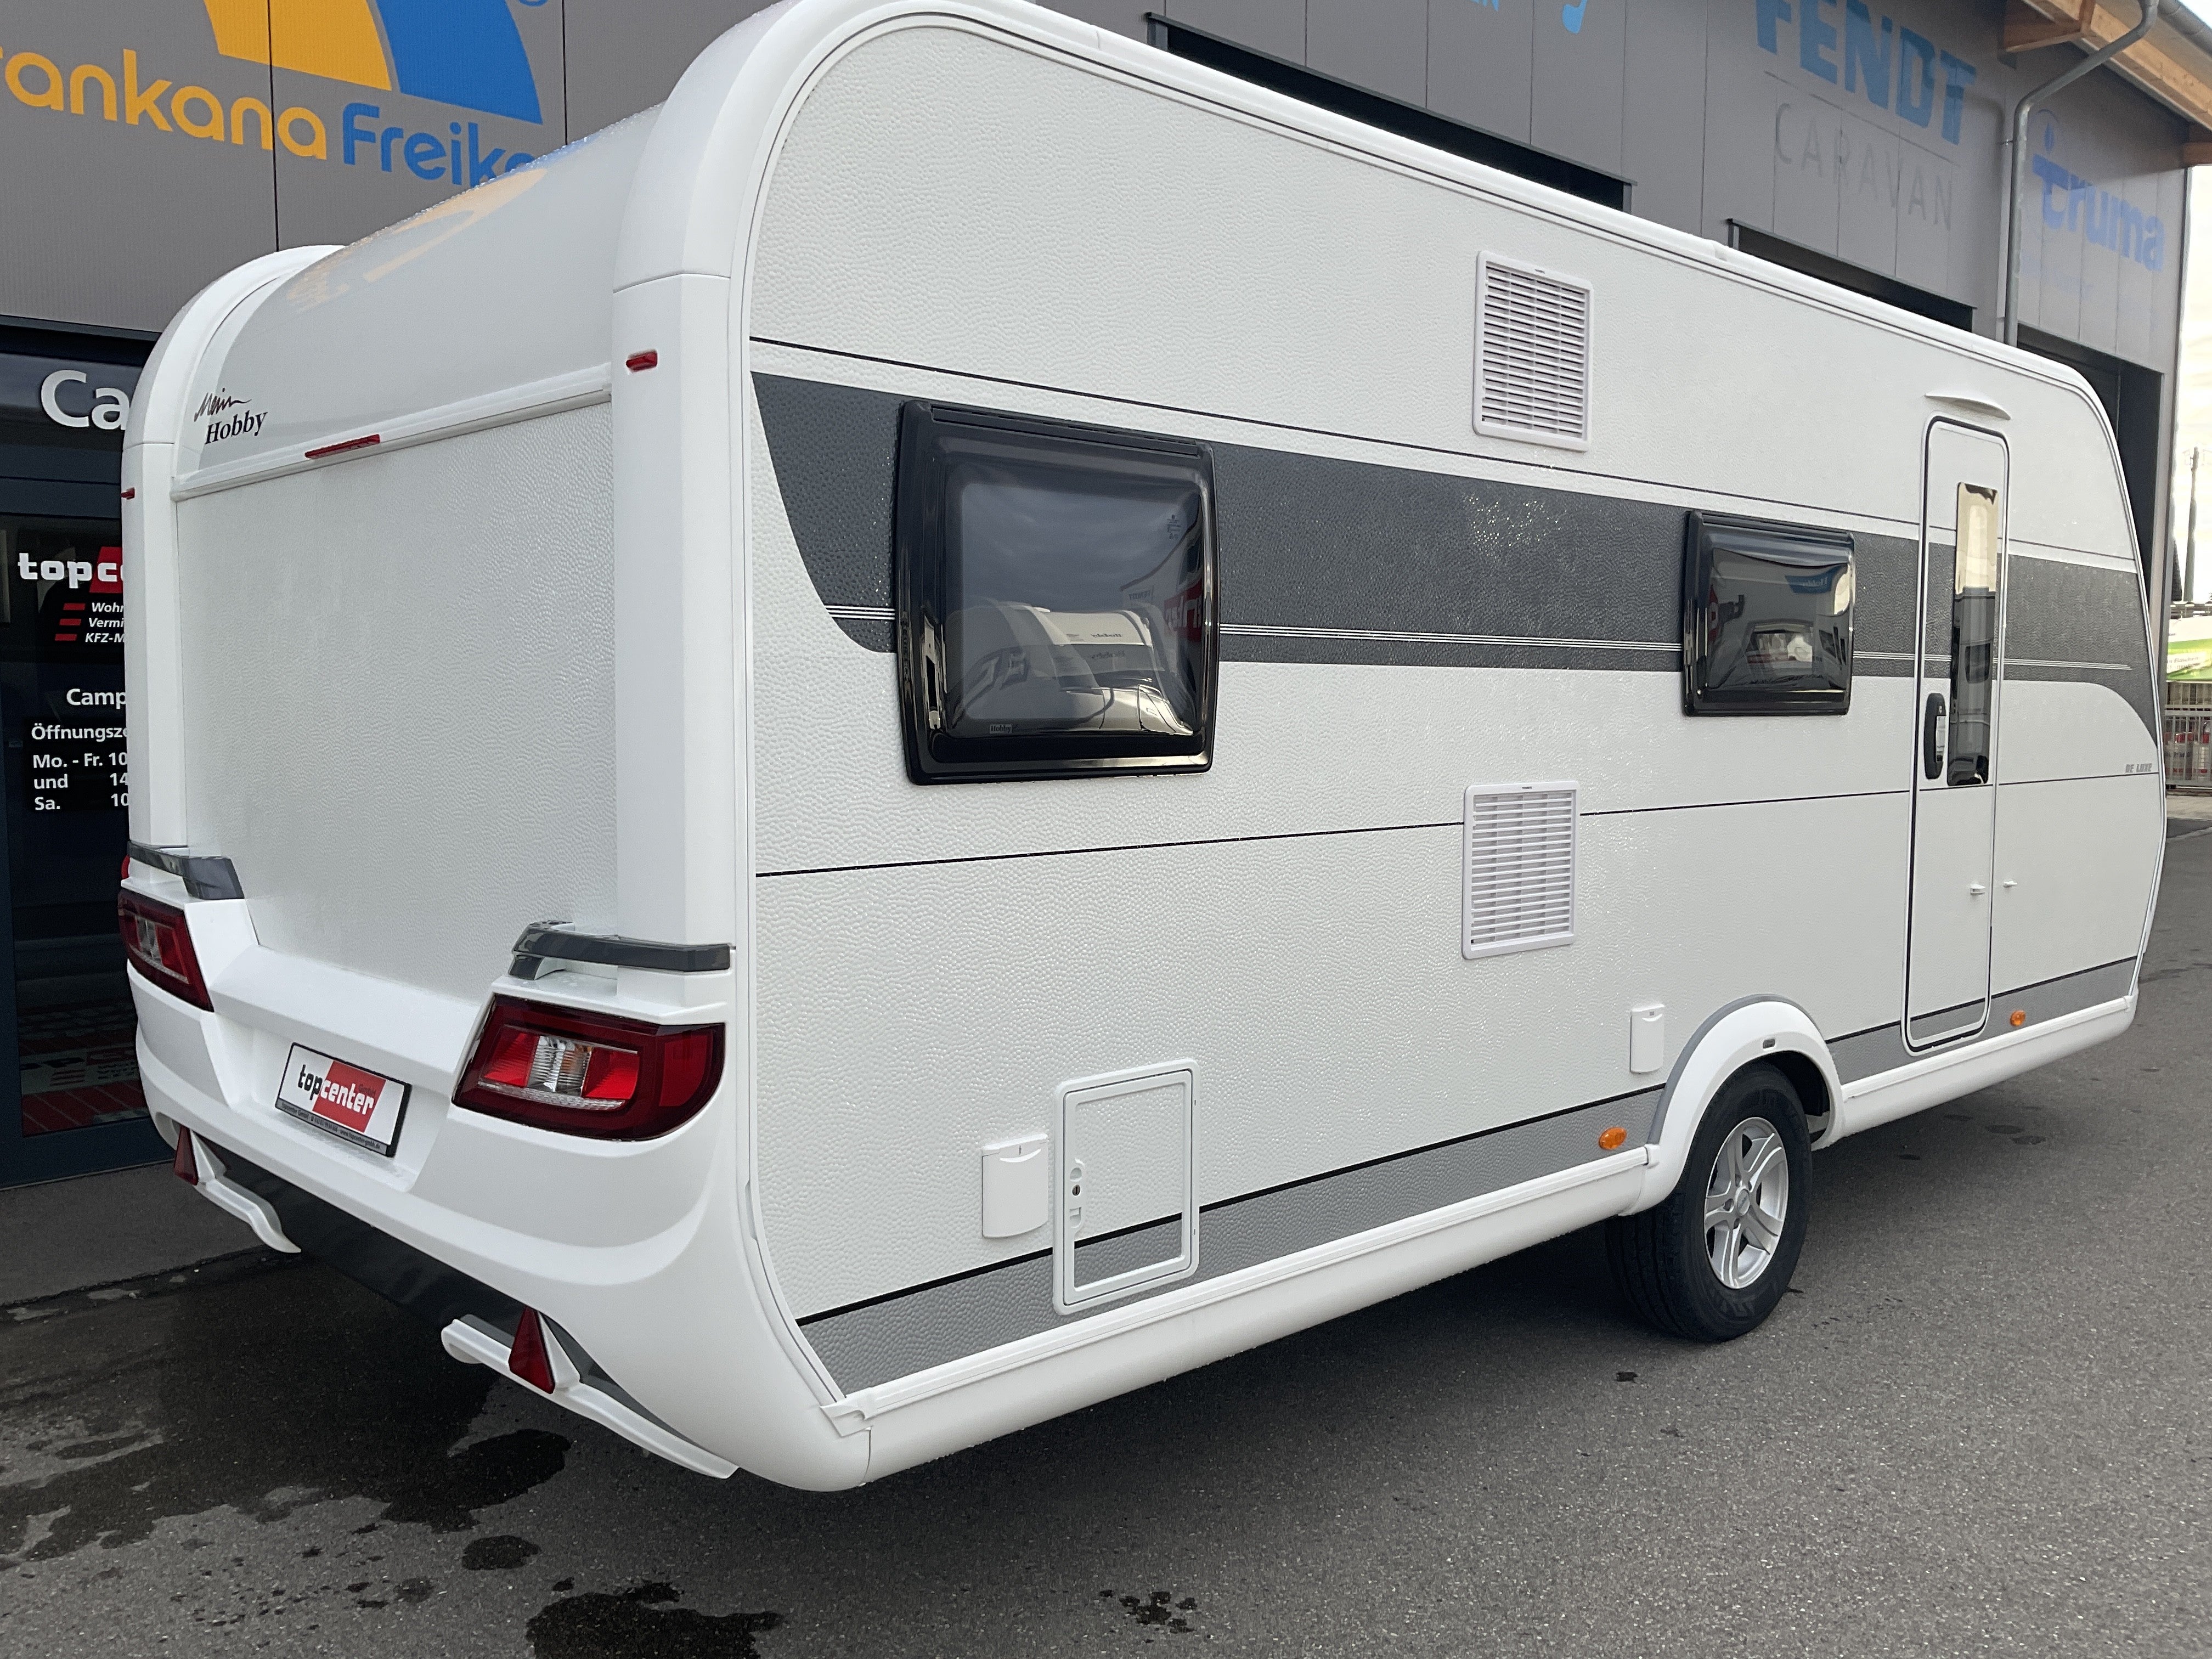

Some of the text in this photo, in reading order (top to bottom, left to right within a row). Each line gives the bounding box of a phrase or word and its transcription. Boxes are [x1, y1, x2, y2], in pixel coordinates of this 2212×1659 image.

[1756, 0, 1976, 146] FENDT
[0, 46, 535, 188] ankana Freik
[1774, 103, 1953, 232] CARAVAN
[2032, 153, 2166, 273] truma
[41, 370, 131, 431] Ca
[204, 410, 268, 445] Hobby
[18, 552, 124, 589] topc
[85, 633, 125, 643] KFZ-M
[88, 617, 125, 628] Vermi
[66, 689, 127, 709] Camp
[33, 754, 67, 769] Mo.
[84, 753, 103, 766] Fr.
[109, 752, 128, 766] 10
[34, 774, 69, 789] und
[35, 793, 129, 811] Sa. 10
[298, 1064, 375, 1115] topcenter
